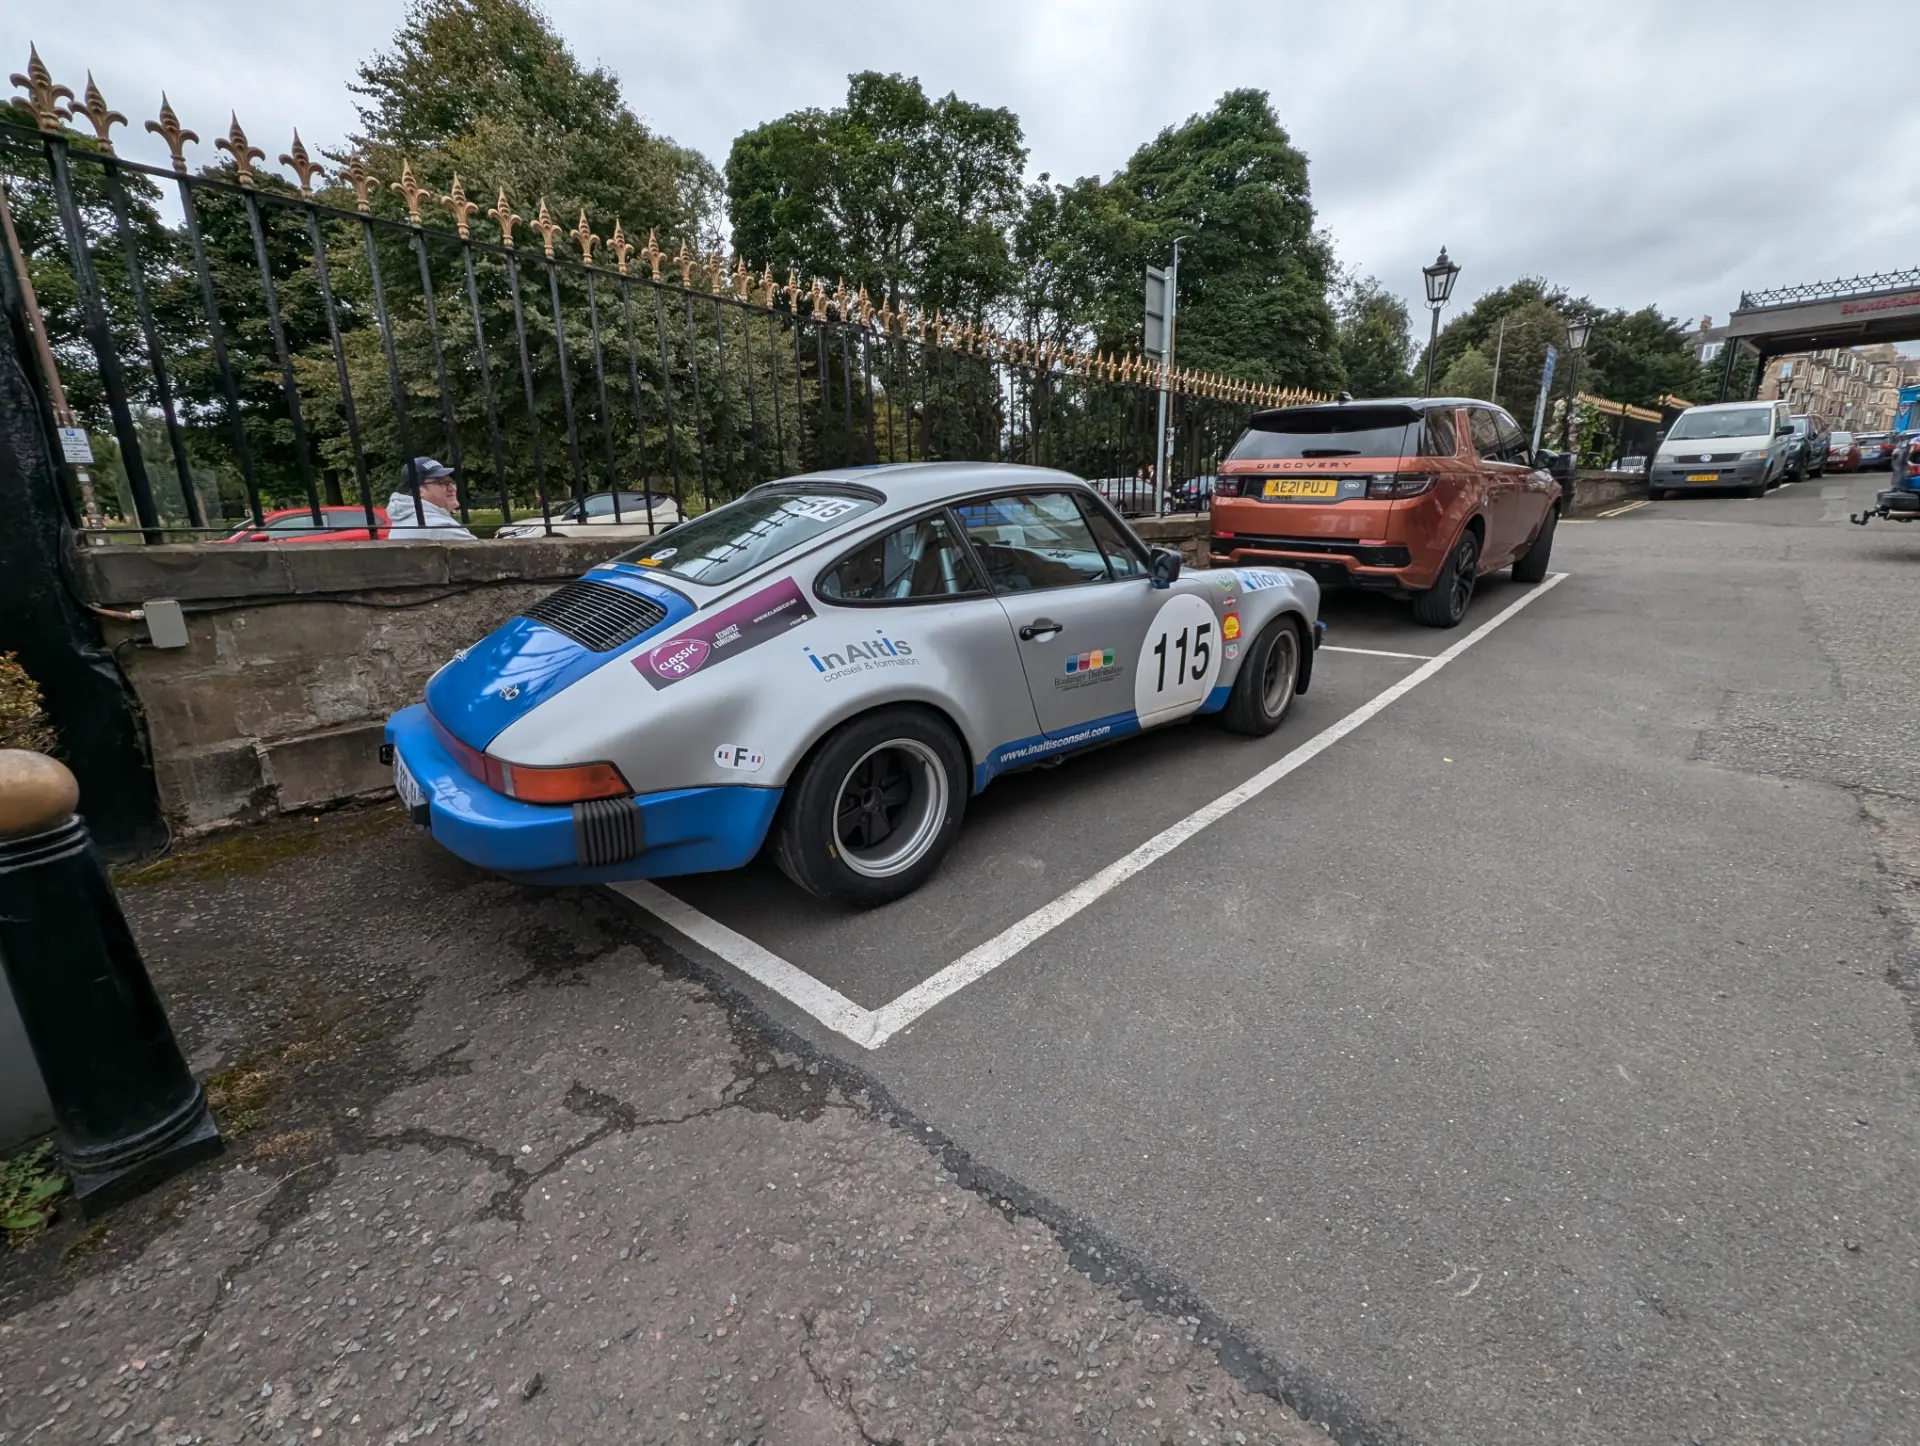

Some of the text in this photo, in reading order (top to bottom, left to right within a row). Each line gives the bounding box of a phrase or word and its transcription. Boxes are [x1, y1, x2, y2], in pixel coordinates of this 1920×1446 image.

[1257, 461, 1353, 469] DISCOVERY
[1272, 480, 1329, 493] AE21 PUJ
[797, 499, 852, 518] 515
[659, 643, 699, 671] CLASSIC
[803, 629, 913, 673] inAltis
[1154, 622, 1212, 693] 115
[673, 660, 690, 674] 21
[823, 657, 920, 683] conseil & formation
[1000, 725, 1111, 763] www.inaltisconseil.com
[733, 747, 749, 767] F
